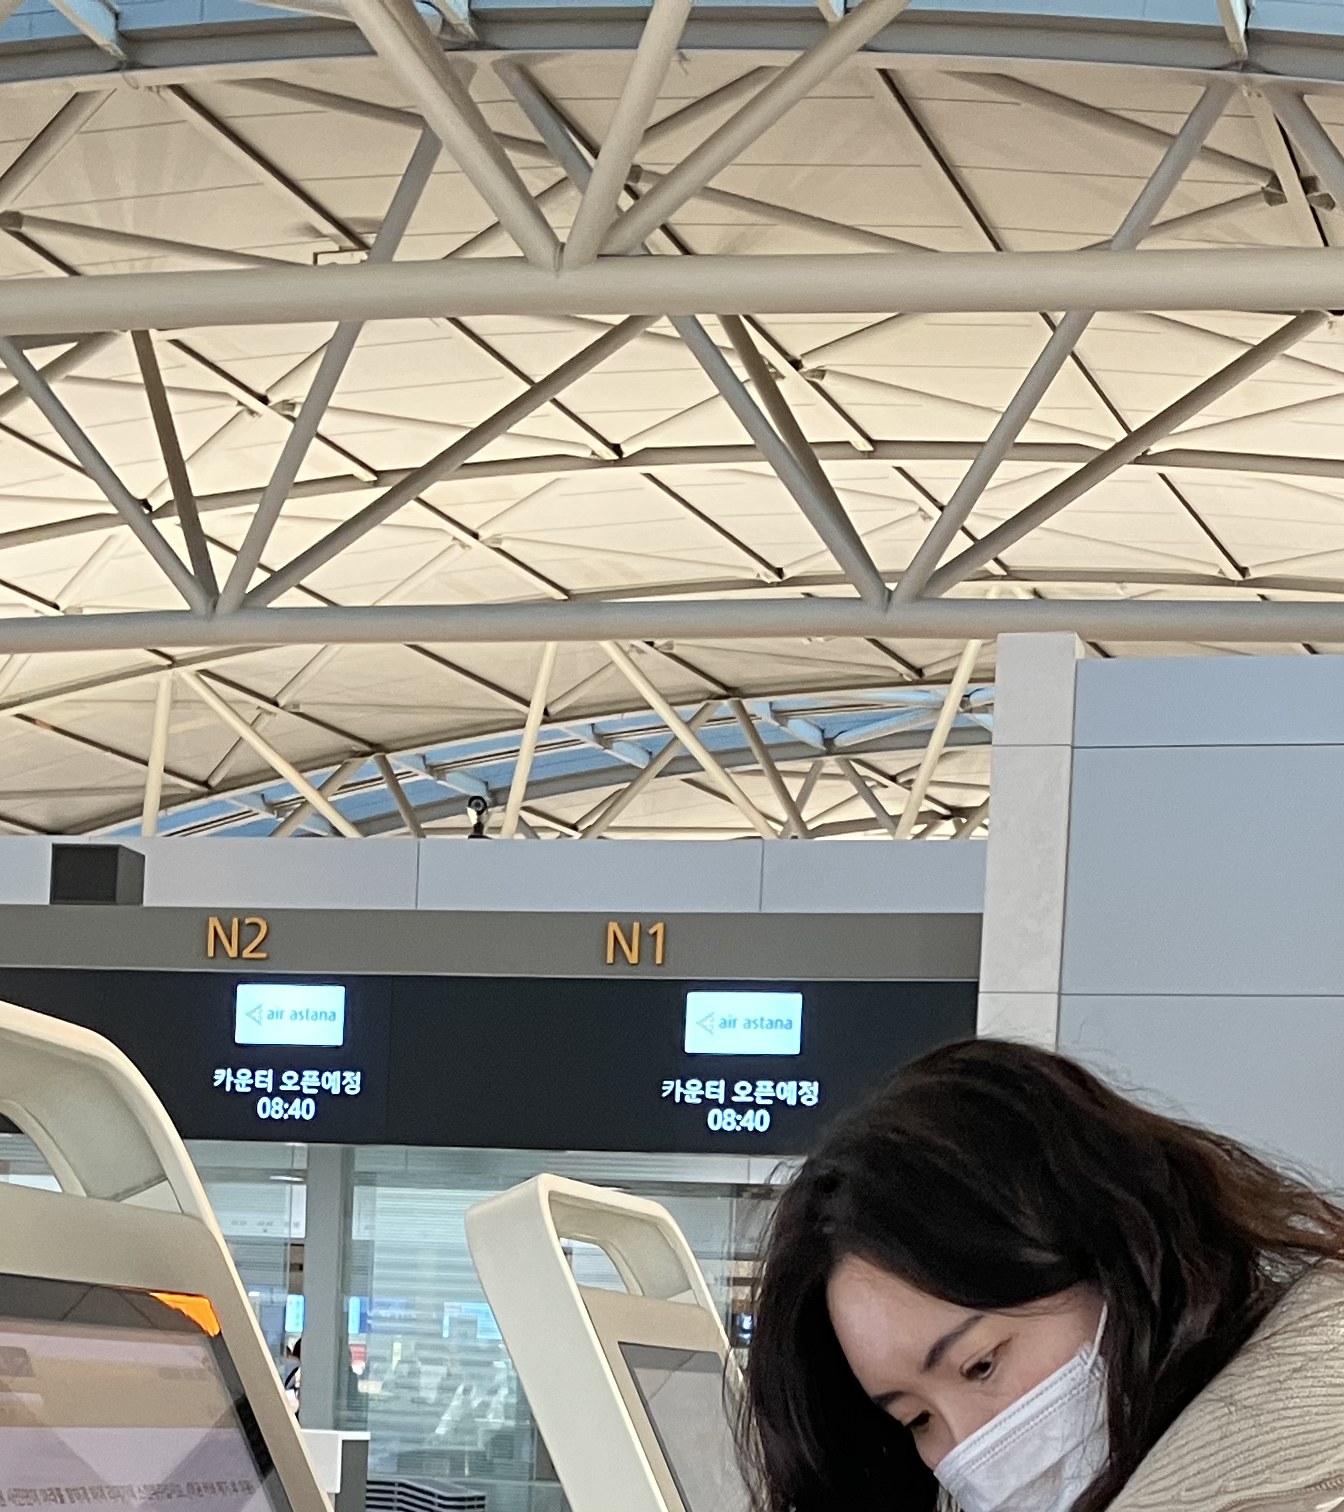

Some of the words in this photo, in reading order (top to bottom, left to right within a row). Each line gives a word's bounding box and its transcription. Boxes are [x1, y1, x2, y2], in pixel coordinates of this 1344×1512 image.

[207, 916, 268, 958] N2
[606, 921, 666, 964] N1
[266, 1009, 285, 1021] air
[289, 1008, 337, 1022] astana
[718, 1015, 738, 1030] air
[742, 1016, 793, 1031] astana
[213, 1067, 274, 1093] 카운터
[279, 1070, 362, 1095] 오픈예정
[661, 1078, 726, 1104] 카운터
[731, 1080, 819, 1106] 오픈예정
[256, 1096, 316, 1120] 08:40
[707, 1108, 771, 1133] 08:40
